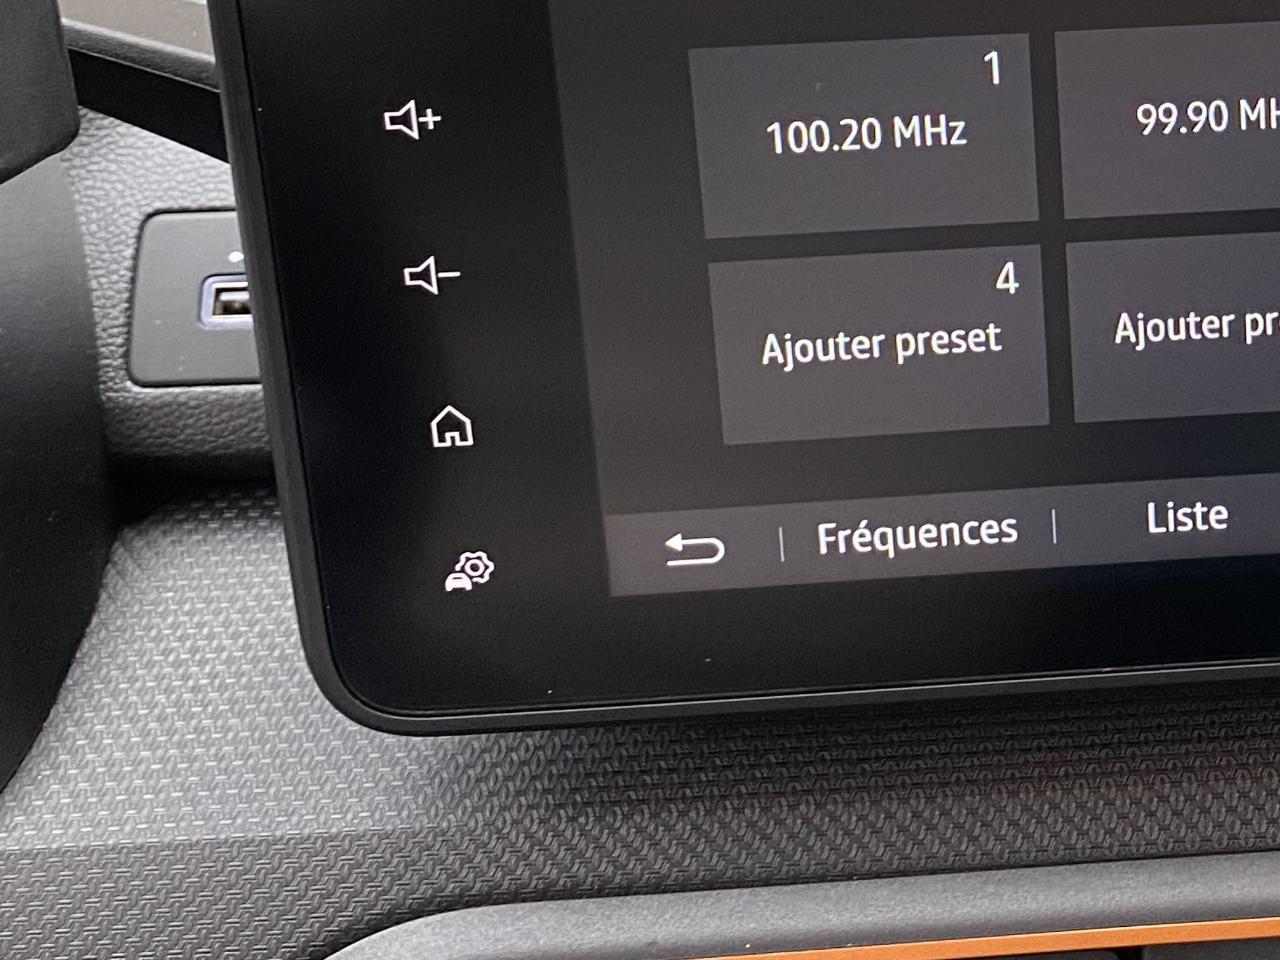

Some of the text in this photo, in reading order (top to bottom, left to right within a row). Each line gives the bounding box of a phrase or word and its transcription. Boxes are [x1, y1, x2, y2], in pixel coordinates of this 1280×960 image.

[983, 50, 1000, 85] 1
[766, 112, 968, 156] 100.20 MHz
[1136, 99, 1229, 136] 99.90
[995, 261, 1020, 296] 4
[761, 321, 1004, 373] Ajouter preset
[1113, 311, 1236, 353] Ajouter
[816, 516, 1020, 559] Fréquences
[1146, 499, 1230, 535] Liste
